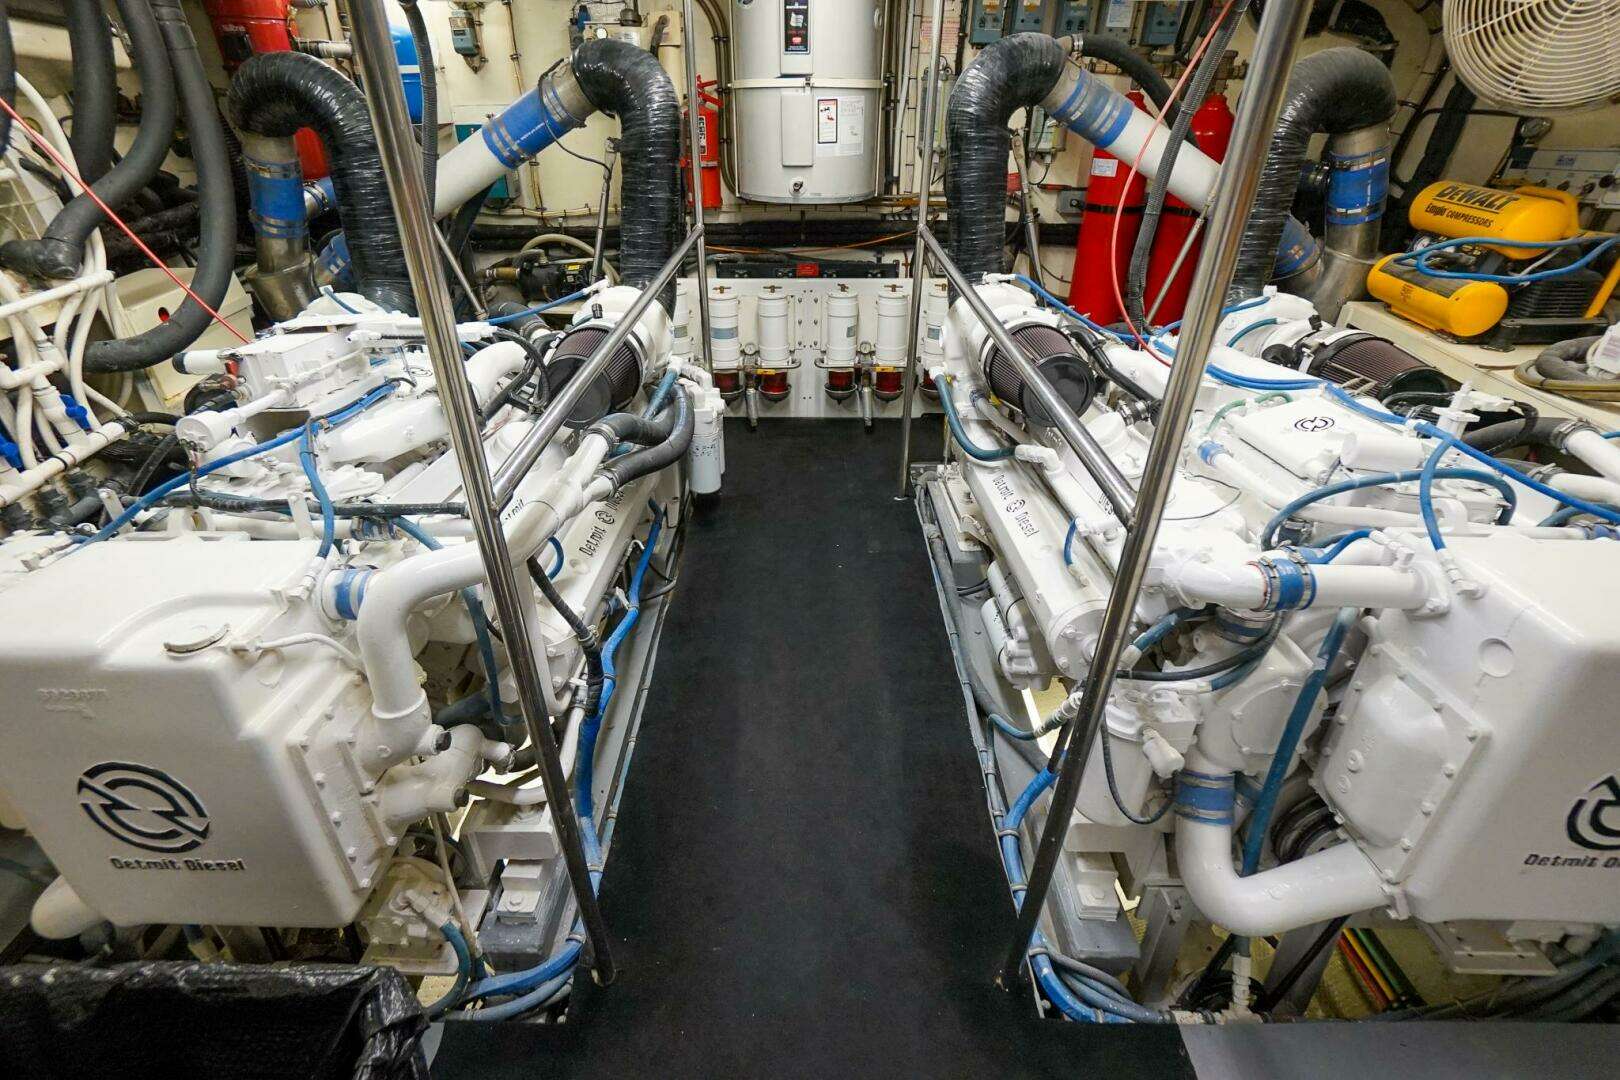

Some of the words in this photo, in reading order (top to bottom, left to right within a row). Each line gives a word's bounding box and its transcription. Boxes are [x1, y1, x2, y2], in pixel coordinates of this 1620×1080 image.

[1435, 184, 1520, 211] DEWALT
[1446, 209, 1494, 228] COMPRESSORS
[1014, 511, 1040, 537] Diesel
[578, 525, 607, 557] Detroit
[109, 857, 181, 870] Detroit
[183, 858, 246, 871] Diesel
[1523, 853, 1599, 868] Detroit
